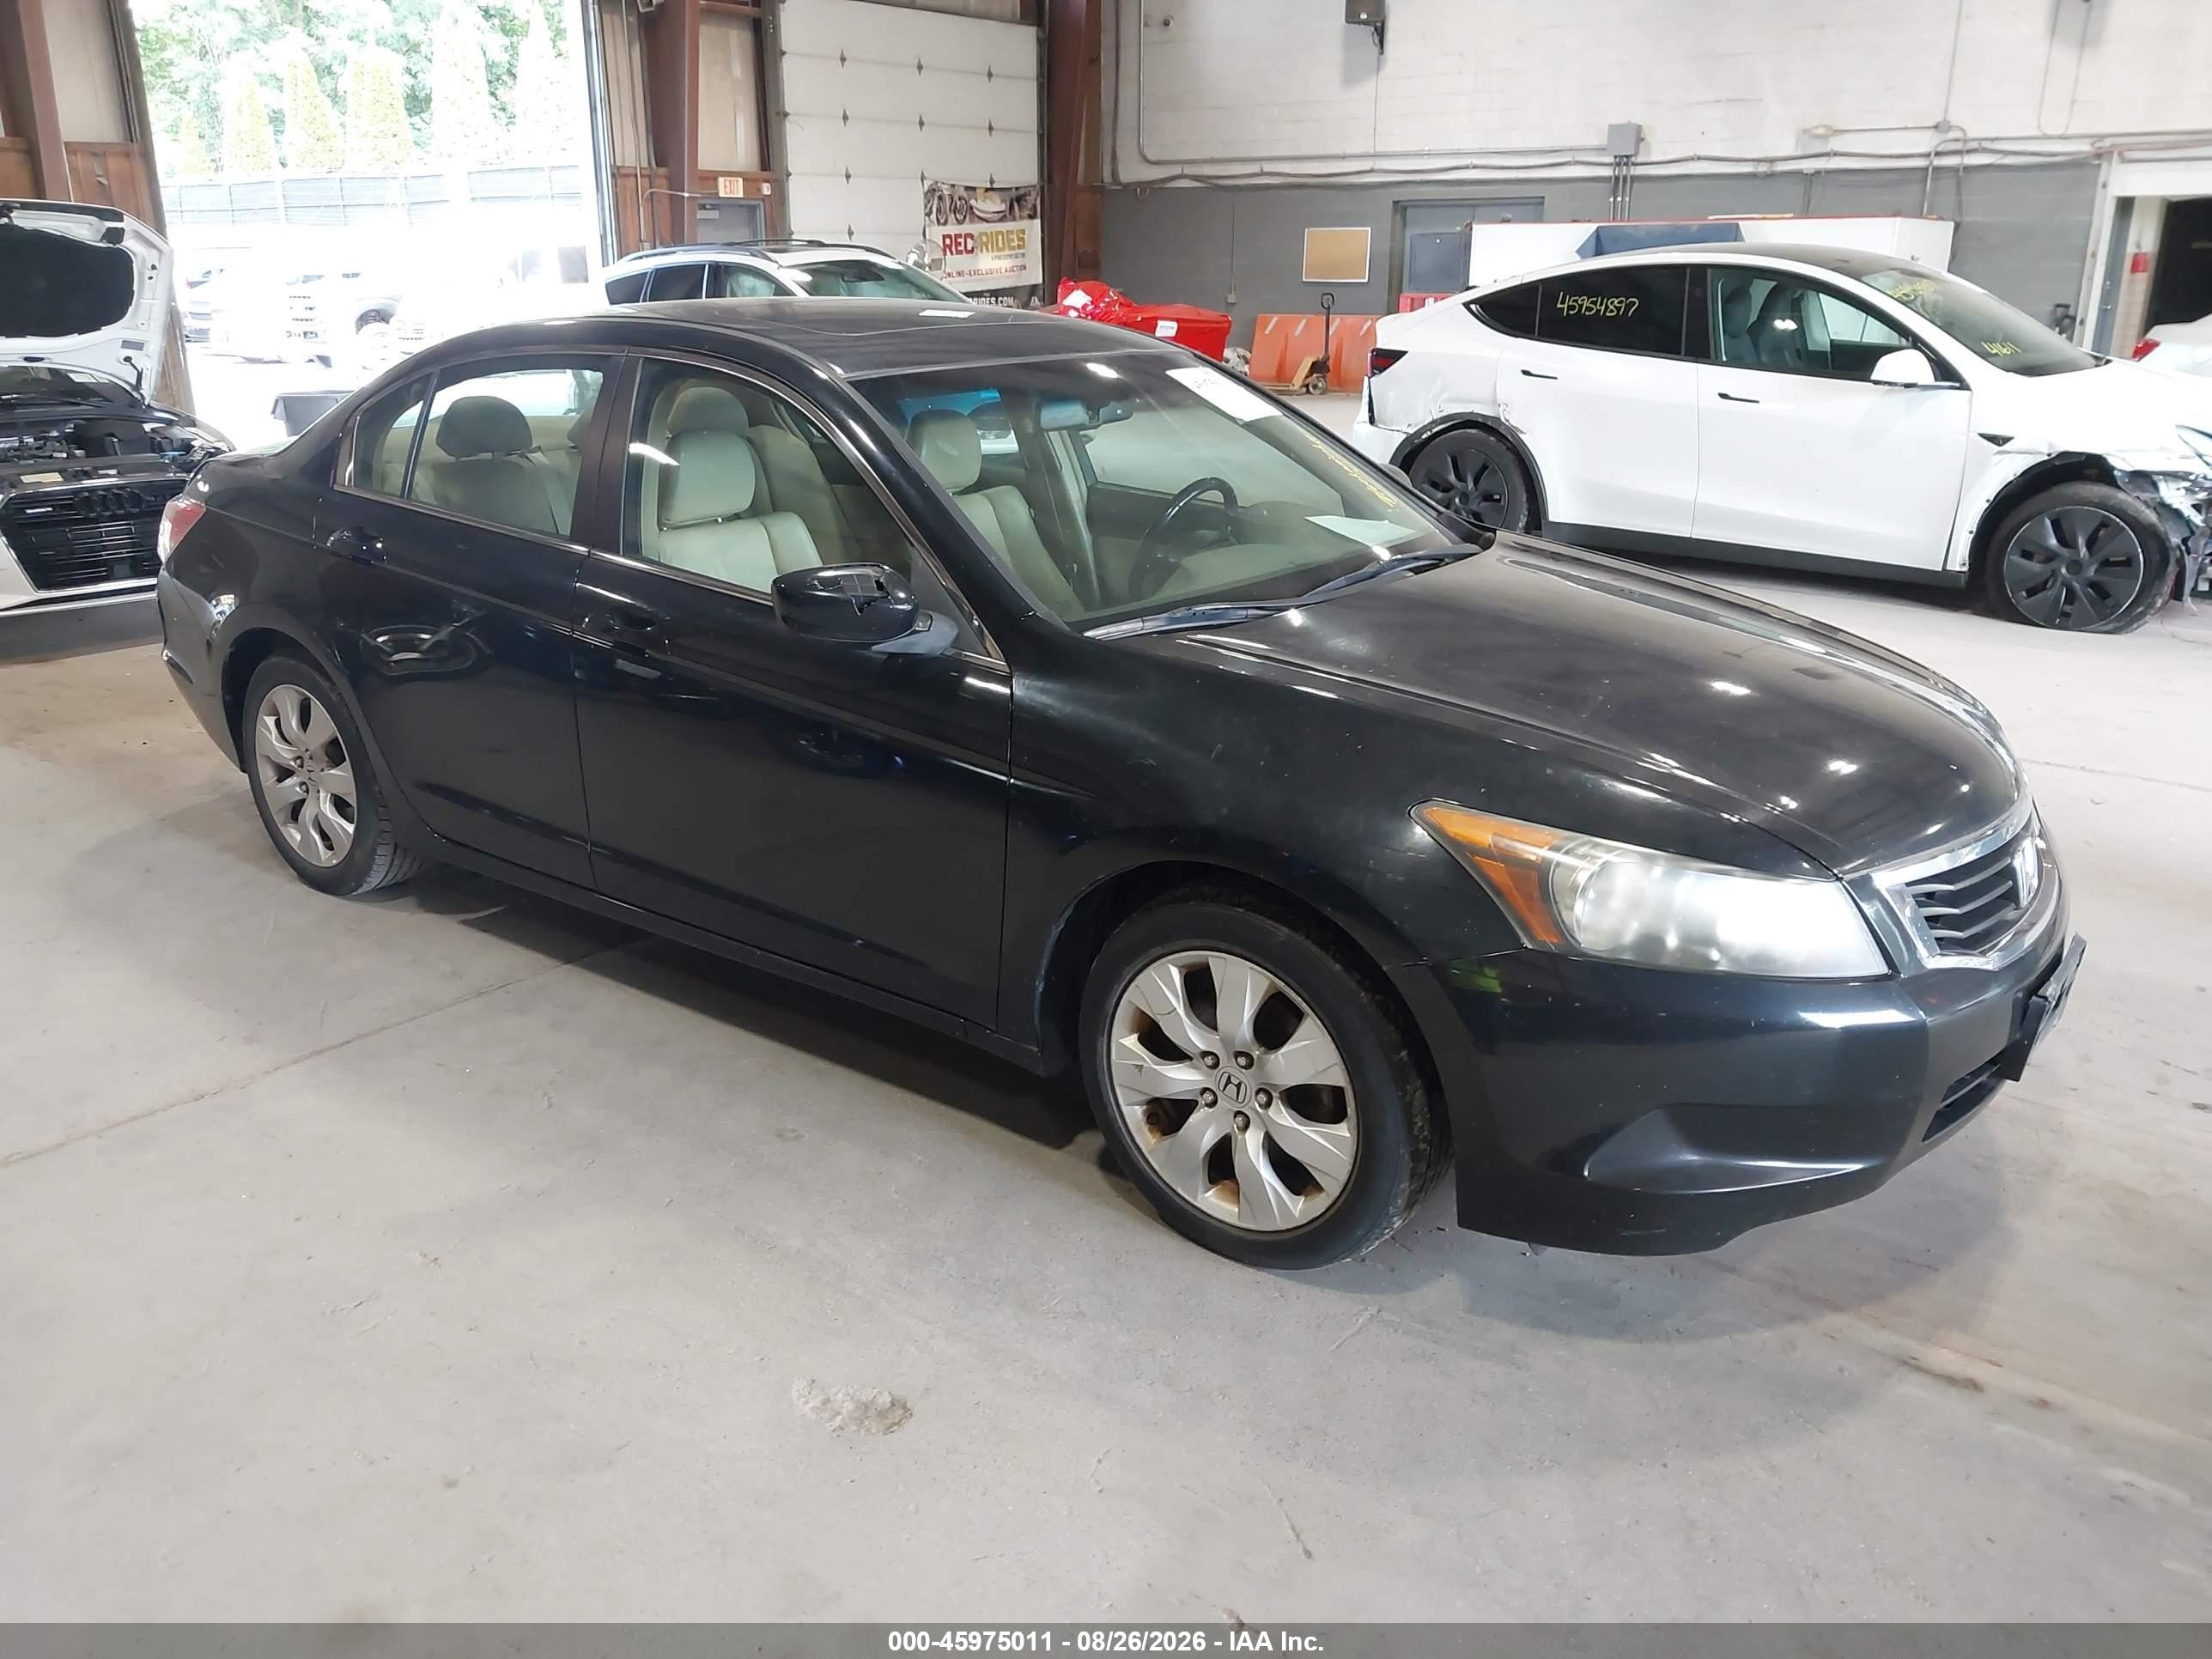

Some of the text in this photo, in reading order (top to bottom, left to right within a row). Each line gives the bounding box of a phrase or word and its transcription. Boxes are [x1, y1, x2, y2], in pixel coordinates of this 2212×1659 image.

[724, 179, 739, 195] EXIT
[942, 228, 1026, 256] REC RIDES
[1004, 264, 1027, 273] AUCTION
[1556, 290, 1639, 317] 45954897
